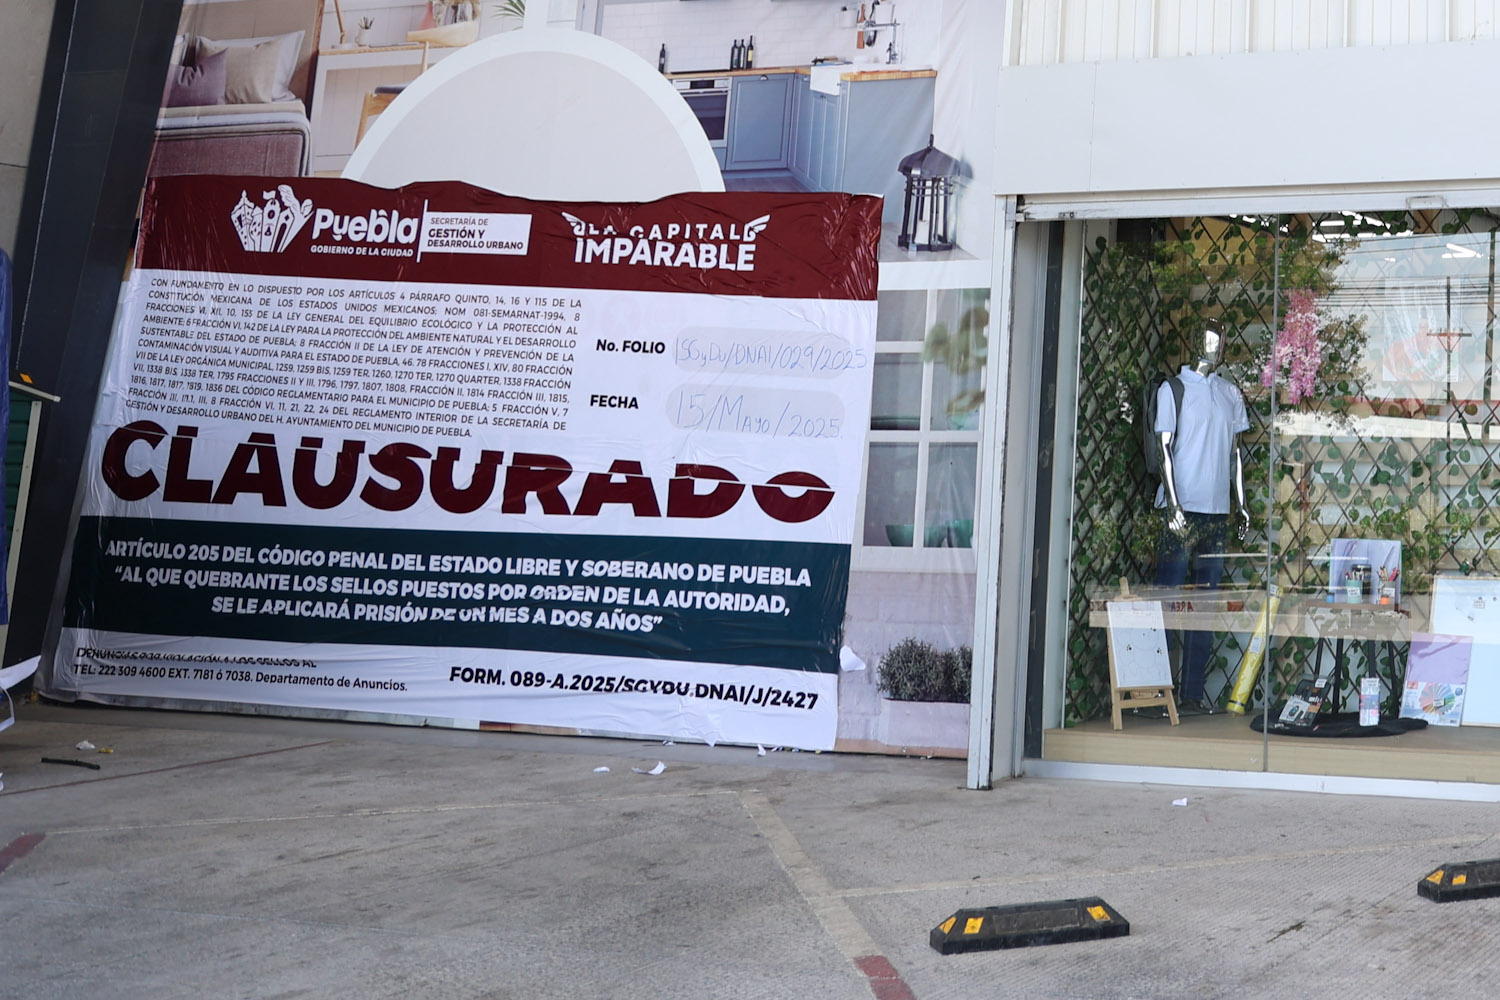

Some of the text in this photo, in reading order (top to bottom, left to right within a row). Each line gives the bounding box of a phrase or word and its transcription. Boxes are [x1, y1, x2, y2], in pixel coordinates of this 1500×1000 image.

[312, 208, 418, 243] Puebla
[427, 227, 484, 239] GESTIÓN Y
[430, 216, 488, 227] SECRETARÍA DE
[629, 223, 740, 240] CAPITAL
[309, 245, 413, 257] GOBIERNO DE LA CIUDAD
[426, 240, 523, 251] DESARROLLO URBANO
[574, 237, 756, 271] IMPARABLE
[150, 278, 168, 286] CON
[257, 285, 302, 295] DISPUESTO
[306, 287, 324, 296] POR
[328, 288, 345, 297] LOS
[348, 287, 396, 300] ARTÍCULOS
[409, 290, 451, 302] PÁRRAFO
[534, 297, 547, 306] 115
[277, 298, 293, 307] LOS
[298, 299, 338, 309] ESTADOS
[344, 302, 377, 312] UNIDOS
[444, 306, 466, 315] NOM
[196, 331, 212, 340] DEL
[214, 332, 246, 342] ESTADO
[308, 336, 351, 349] FRACCIÓN
[391, 343, 407, 353] LEY
[425, 343, 471, 356] ATENCIÓN
[483, 346, 542, 360] PREVENCIÓN
[203, 344, 233, 354] VISUAL
[240, 347, 279, 357] AUDITIVA
[280, 350, 303, 359] PARA
[316, 352, 350, 362] ESTADO
[428, 358, 485, 370] FRACCIONES
[524, 362, 572, 375] FRACCIÓN
[595, 339, 666, 355] No. FOLIO
[590, 394, 639, 409] FECHA
[165, 405, 220, 418] DESARROLLO
[220, 410, 257, 421] URBANO
[258, 413, 275, 423] DEL
[285, 415, 353, 429] AYUNTAMIENTO
[354, 421, 372, 430] DEL
[373, 421, 420, 433] MUNICIPIO
[435, 426, 472, 437] PUEBLA.
[101, 419, 836, 523] CLAUSURADO
[104, 537, 812, 585] ARTÍCULO 205 DEL CÓDIGO PENAL DEL ESTADO LIBRE Y SOBERANO DE PUEBLA
[144, 567, 181, 587] QUE
[182, 569, 291, 592] QUEBRANTE
[292, 574, 328, 592] LOS
[329, 576, 399, 595] SELLOS
[400, 579, 486, 599] PUESTOS
[486, 583, 527, 601] POR
[601, 588, 631, 605] DE
[632, 589, 662, 607] LA
[662, 591, 791, 615] AUTORIDAD,
[210, 597, 234, 614] SE
[235, 598, 258, 615] LE
[258, 596, 352, 619] APLICARÁ
[352, 599, 429, 622] PRISIÓN
[487, 608, 530, 626] MES
[531, 610, 548, 627] A
[549, 611, 593, 629] DOS
[70, 663, 96, 676] TEL:
[97, 665, 116, 677] 222
[117, 666, 137, 678] 309
[138, 667, 166, 679] 4600
[167, 668, 190, 680] EXT.
[192, 670, 213, 682] 7181
[224, 671, 253, 684] 7038.
[254, 673, 334, 689] Departamento
[335, 677, 351, 689] de
[352, 678, 408, 691] Anuncios.
[448, 666, 507, 687] FORM.
